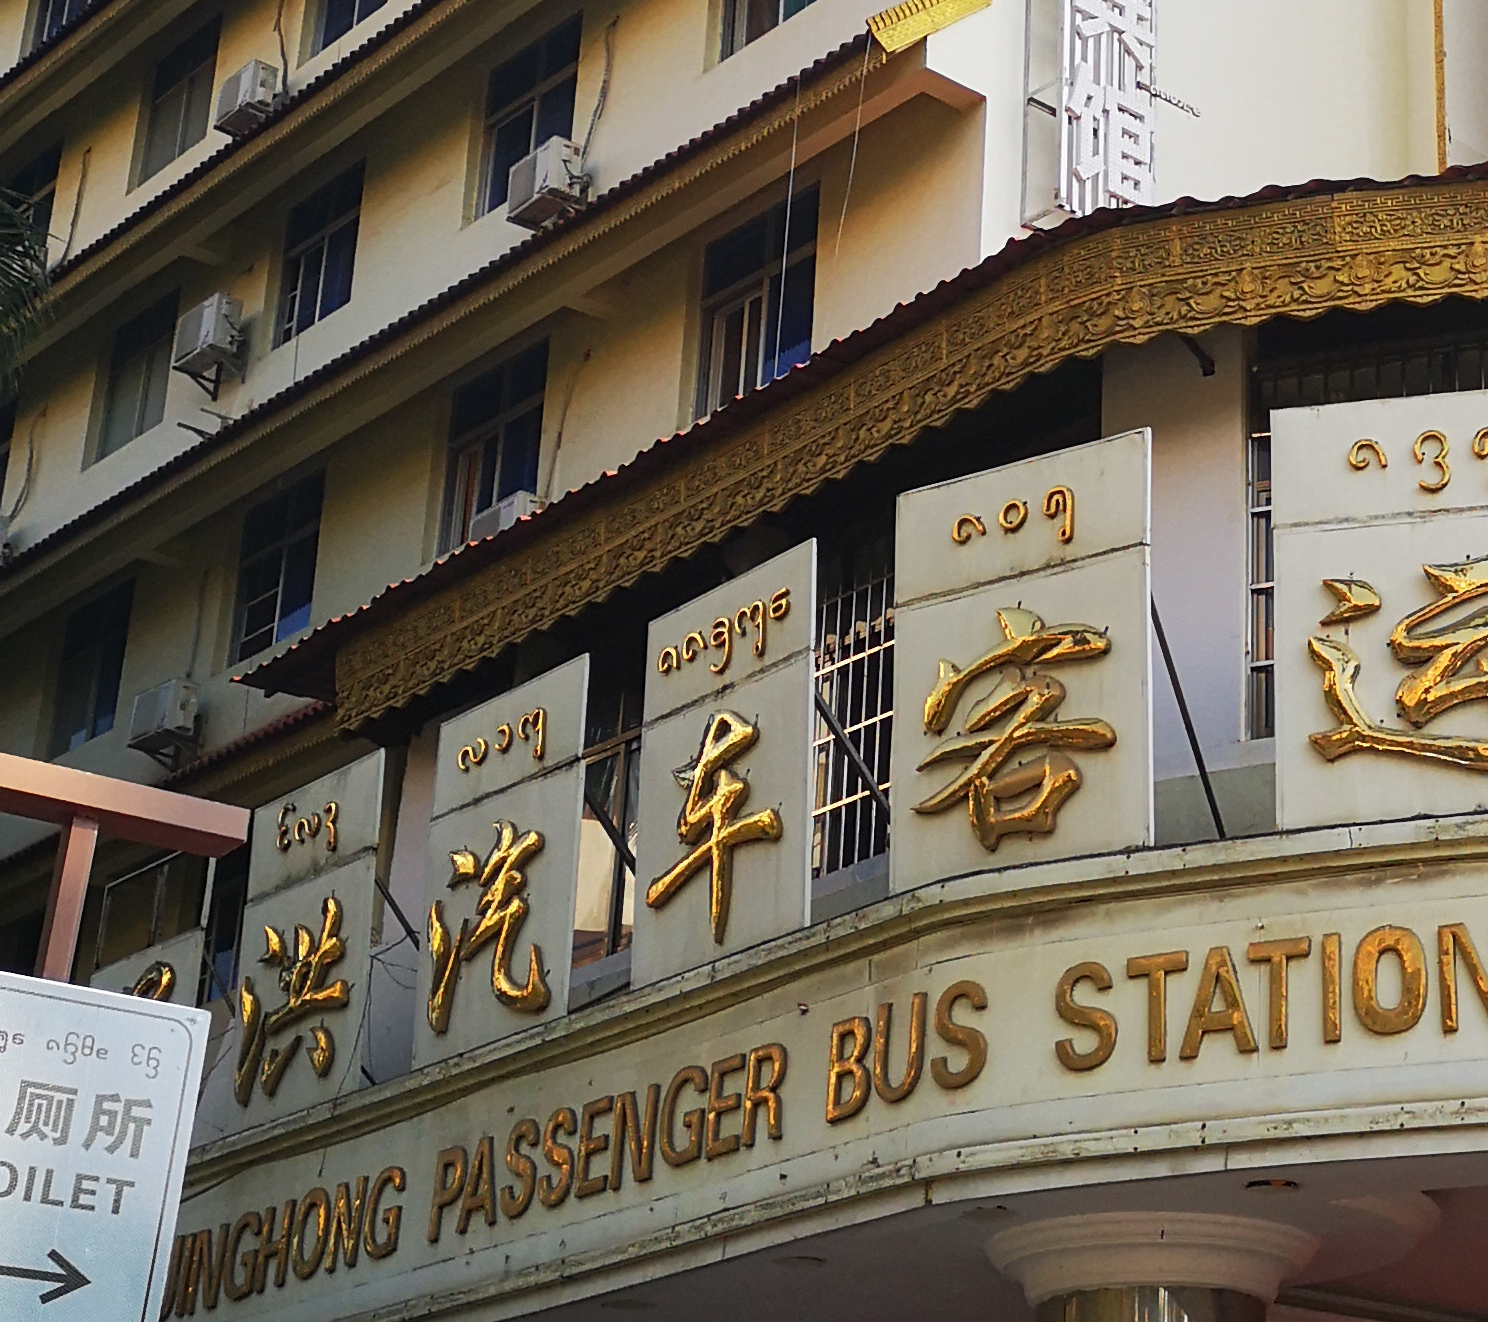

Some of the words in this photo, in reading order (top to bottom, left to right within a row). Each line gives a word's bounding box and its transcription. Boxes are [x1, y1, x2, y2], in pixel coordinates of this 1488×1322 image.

[4, 1079, 154, 1161] 厕所
[427, 1039, 787, 1245] PASSENGER
[824, 977, 990, 1124] BUS
